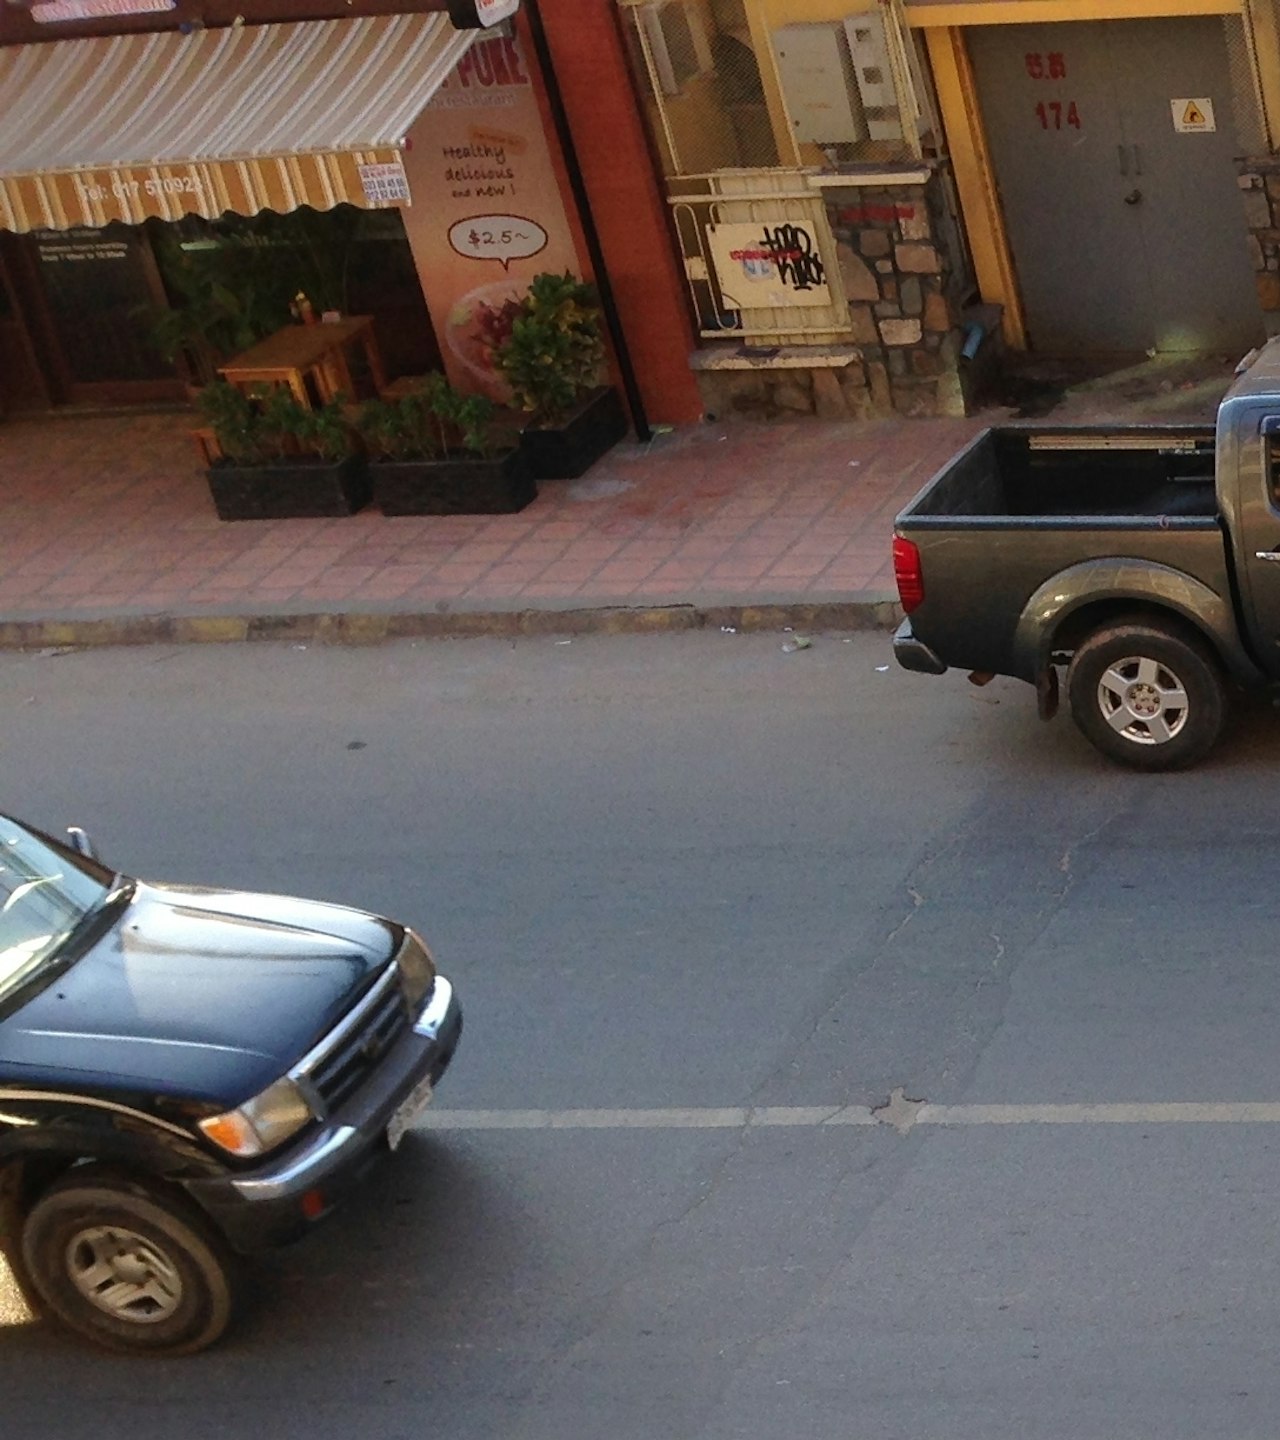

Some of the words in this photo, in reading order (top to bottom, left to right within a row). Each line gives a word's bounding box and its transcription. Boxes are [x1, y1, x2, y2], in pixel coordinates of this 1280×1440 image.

[1036, 101, 1081, 129] 174
[442, 144, 505, 165] Healthy
[445, 168, 514, 181] delicious
